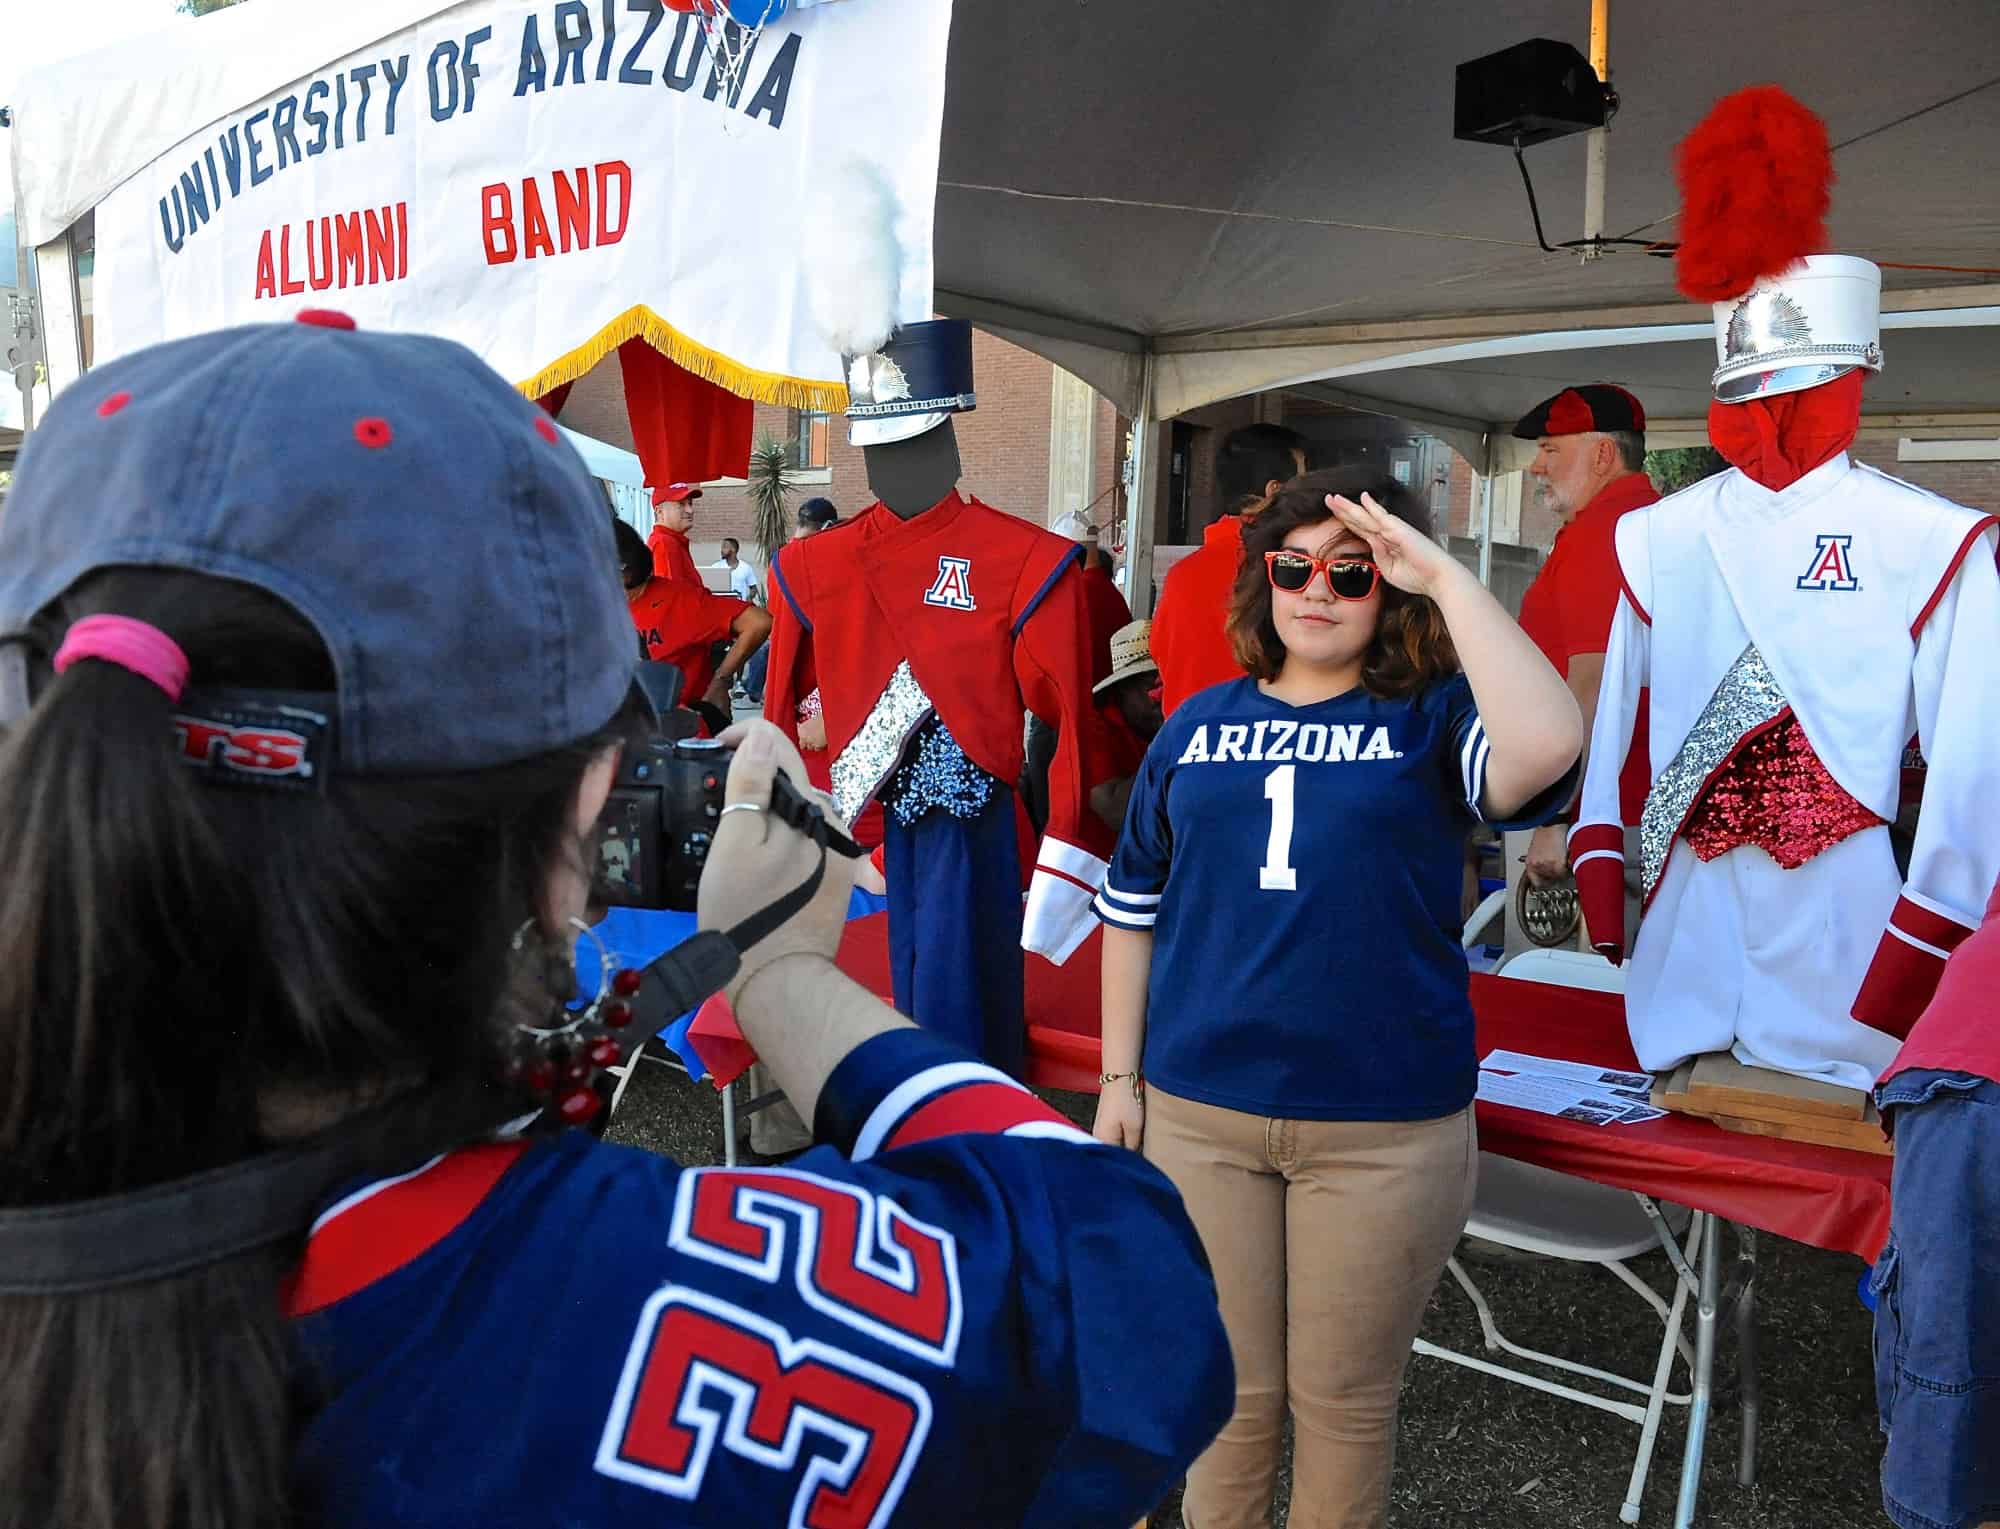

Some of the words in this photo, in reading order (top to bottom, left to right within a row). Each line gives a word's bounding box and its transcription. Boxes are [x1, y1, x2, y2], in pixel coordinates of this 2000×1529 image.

[159, 54, 410, 254] UNIVERSITY
[427, 25, 492, 122] OF
[513, 0, 802, 130] ARIZONA
[255, 201, 408, 300] ALUMNI
[481, 160, 632, 266] BAND
[924, 555, 974, 611] A
[1796, 534, 1858, 591] A
[1177, 719, 1403, 765] ARIZONA
[1259, 764, 1297, 891] 1
[593, 1166, 963, 1529] 32
